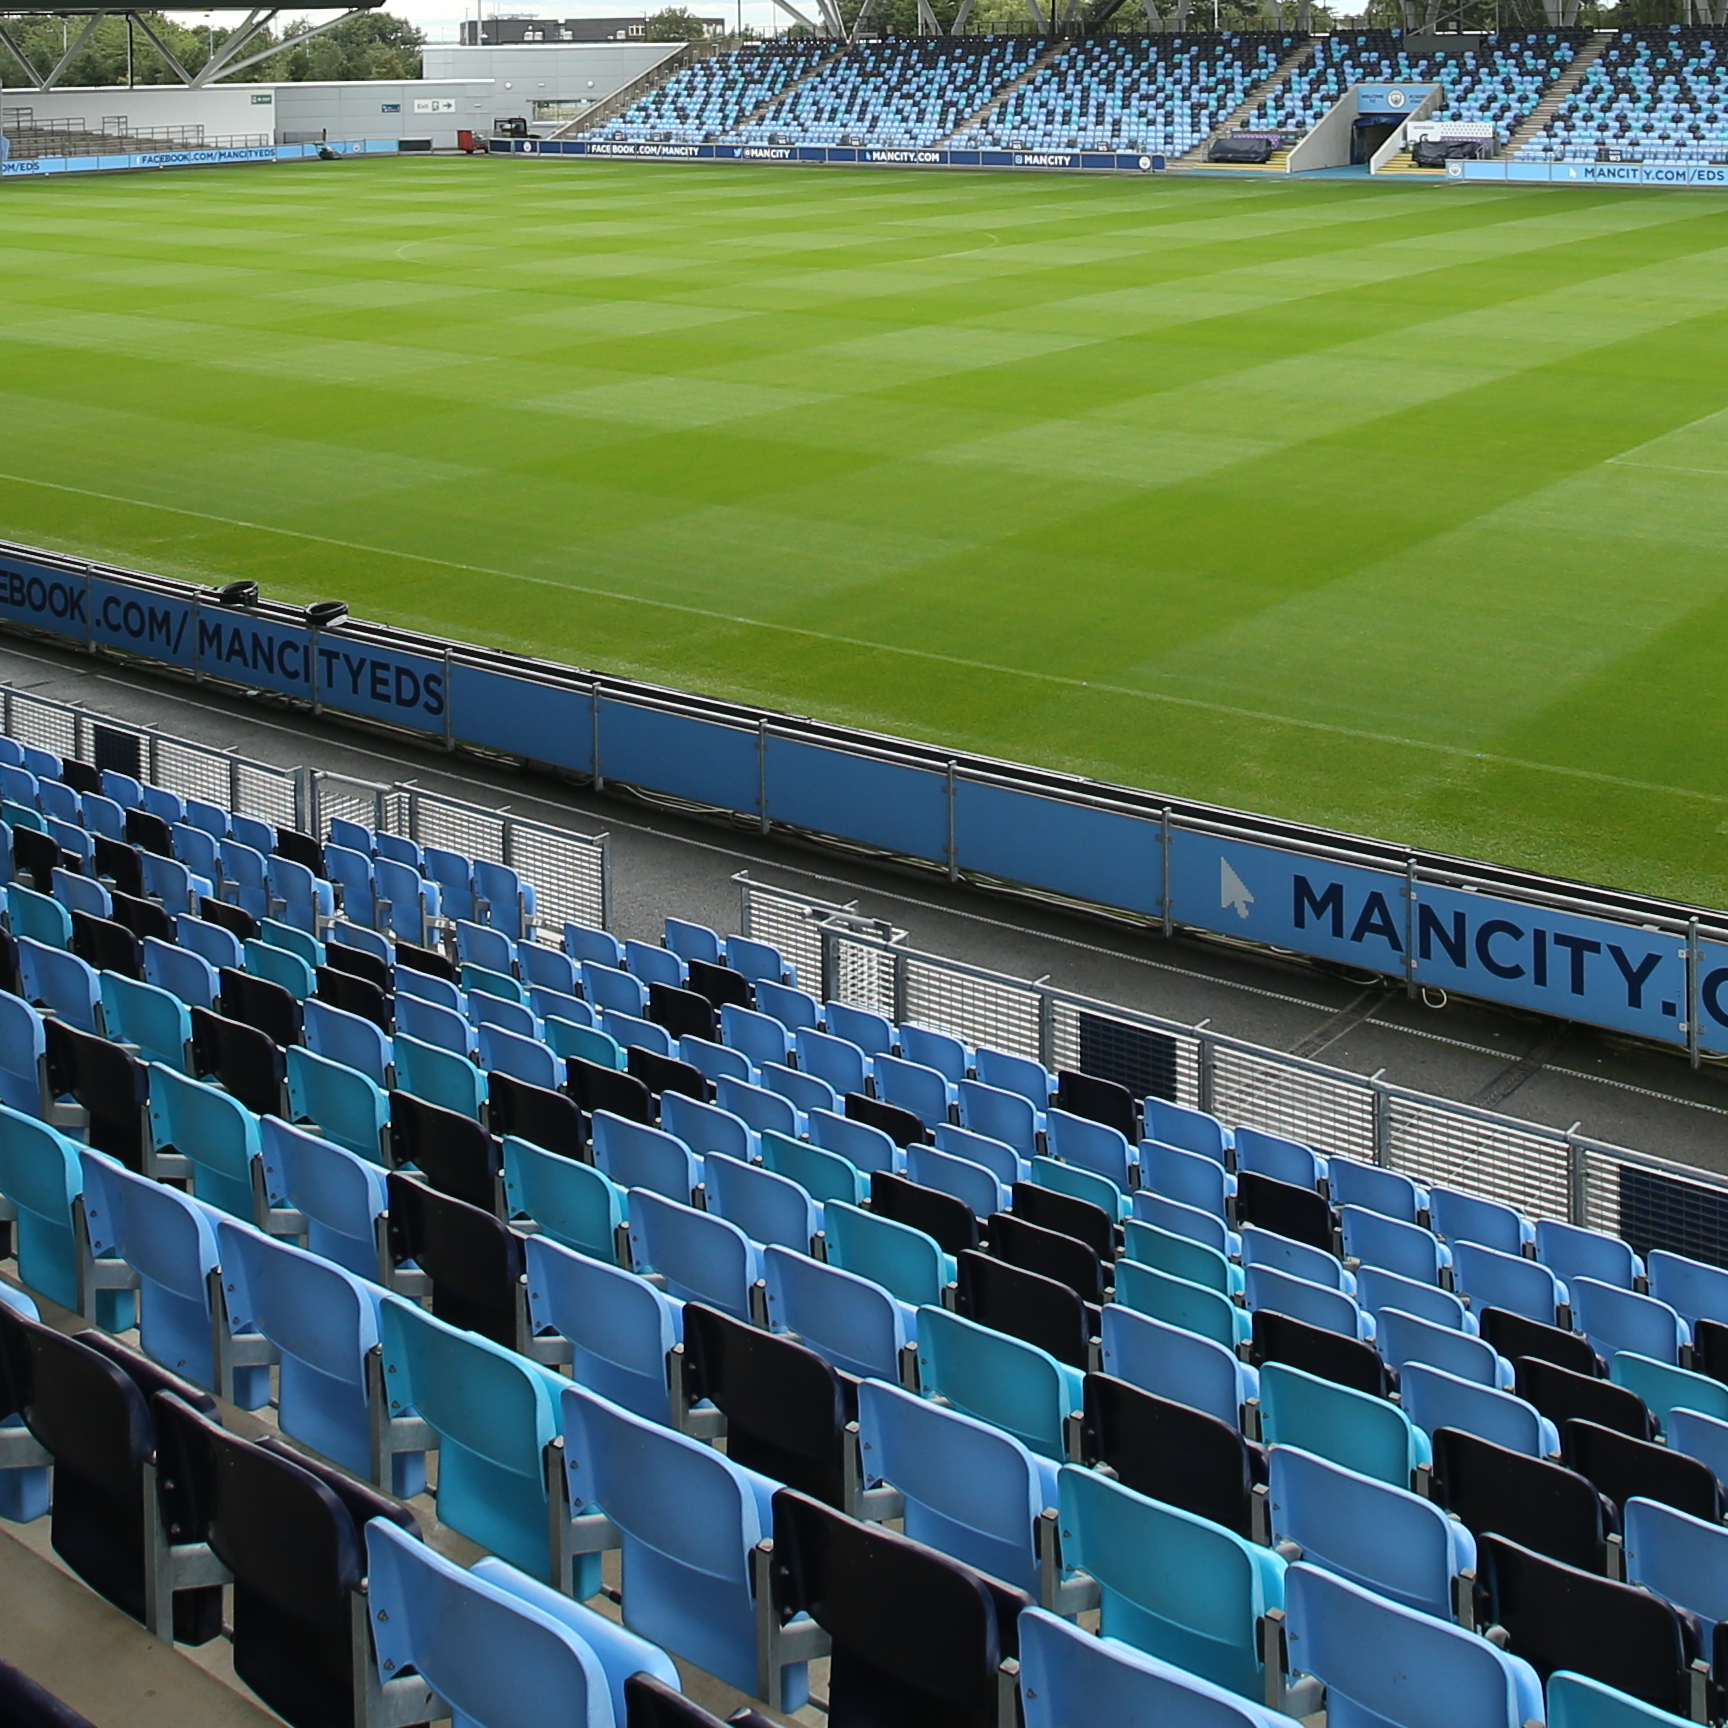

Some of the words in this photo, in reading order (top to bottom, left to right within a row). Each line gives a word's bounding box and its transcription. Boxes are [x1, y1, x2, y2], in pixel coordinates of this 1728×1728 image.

[142, 148, 276, 164] FACEBOOK.COM/MANCITYEDS
[591, 144, 699, 157] FACEBOOK.COM/MANCITY
[743, 147, 791, 159] @MANCITY
[872, 150, 940, 162] MANCITY.COM
[1024, 154, 1071, 166] MANCITY
[1584, 168, 1725, 181] MANCITY.COM/EDS
